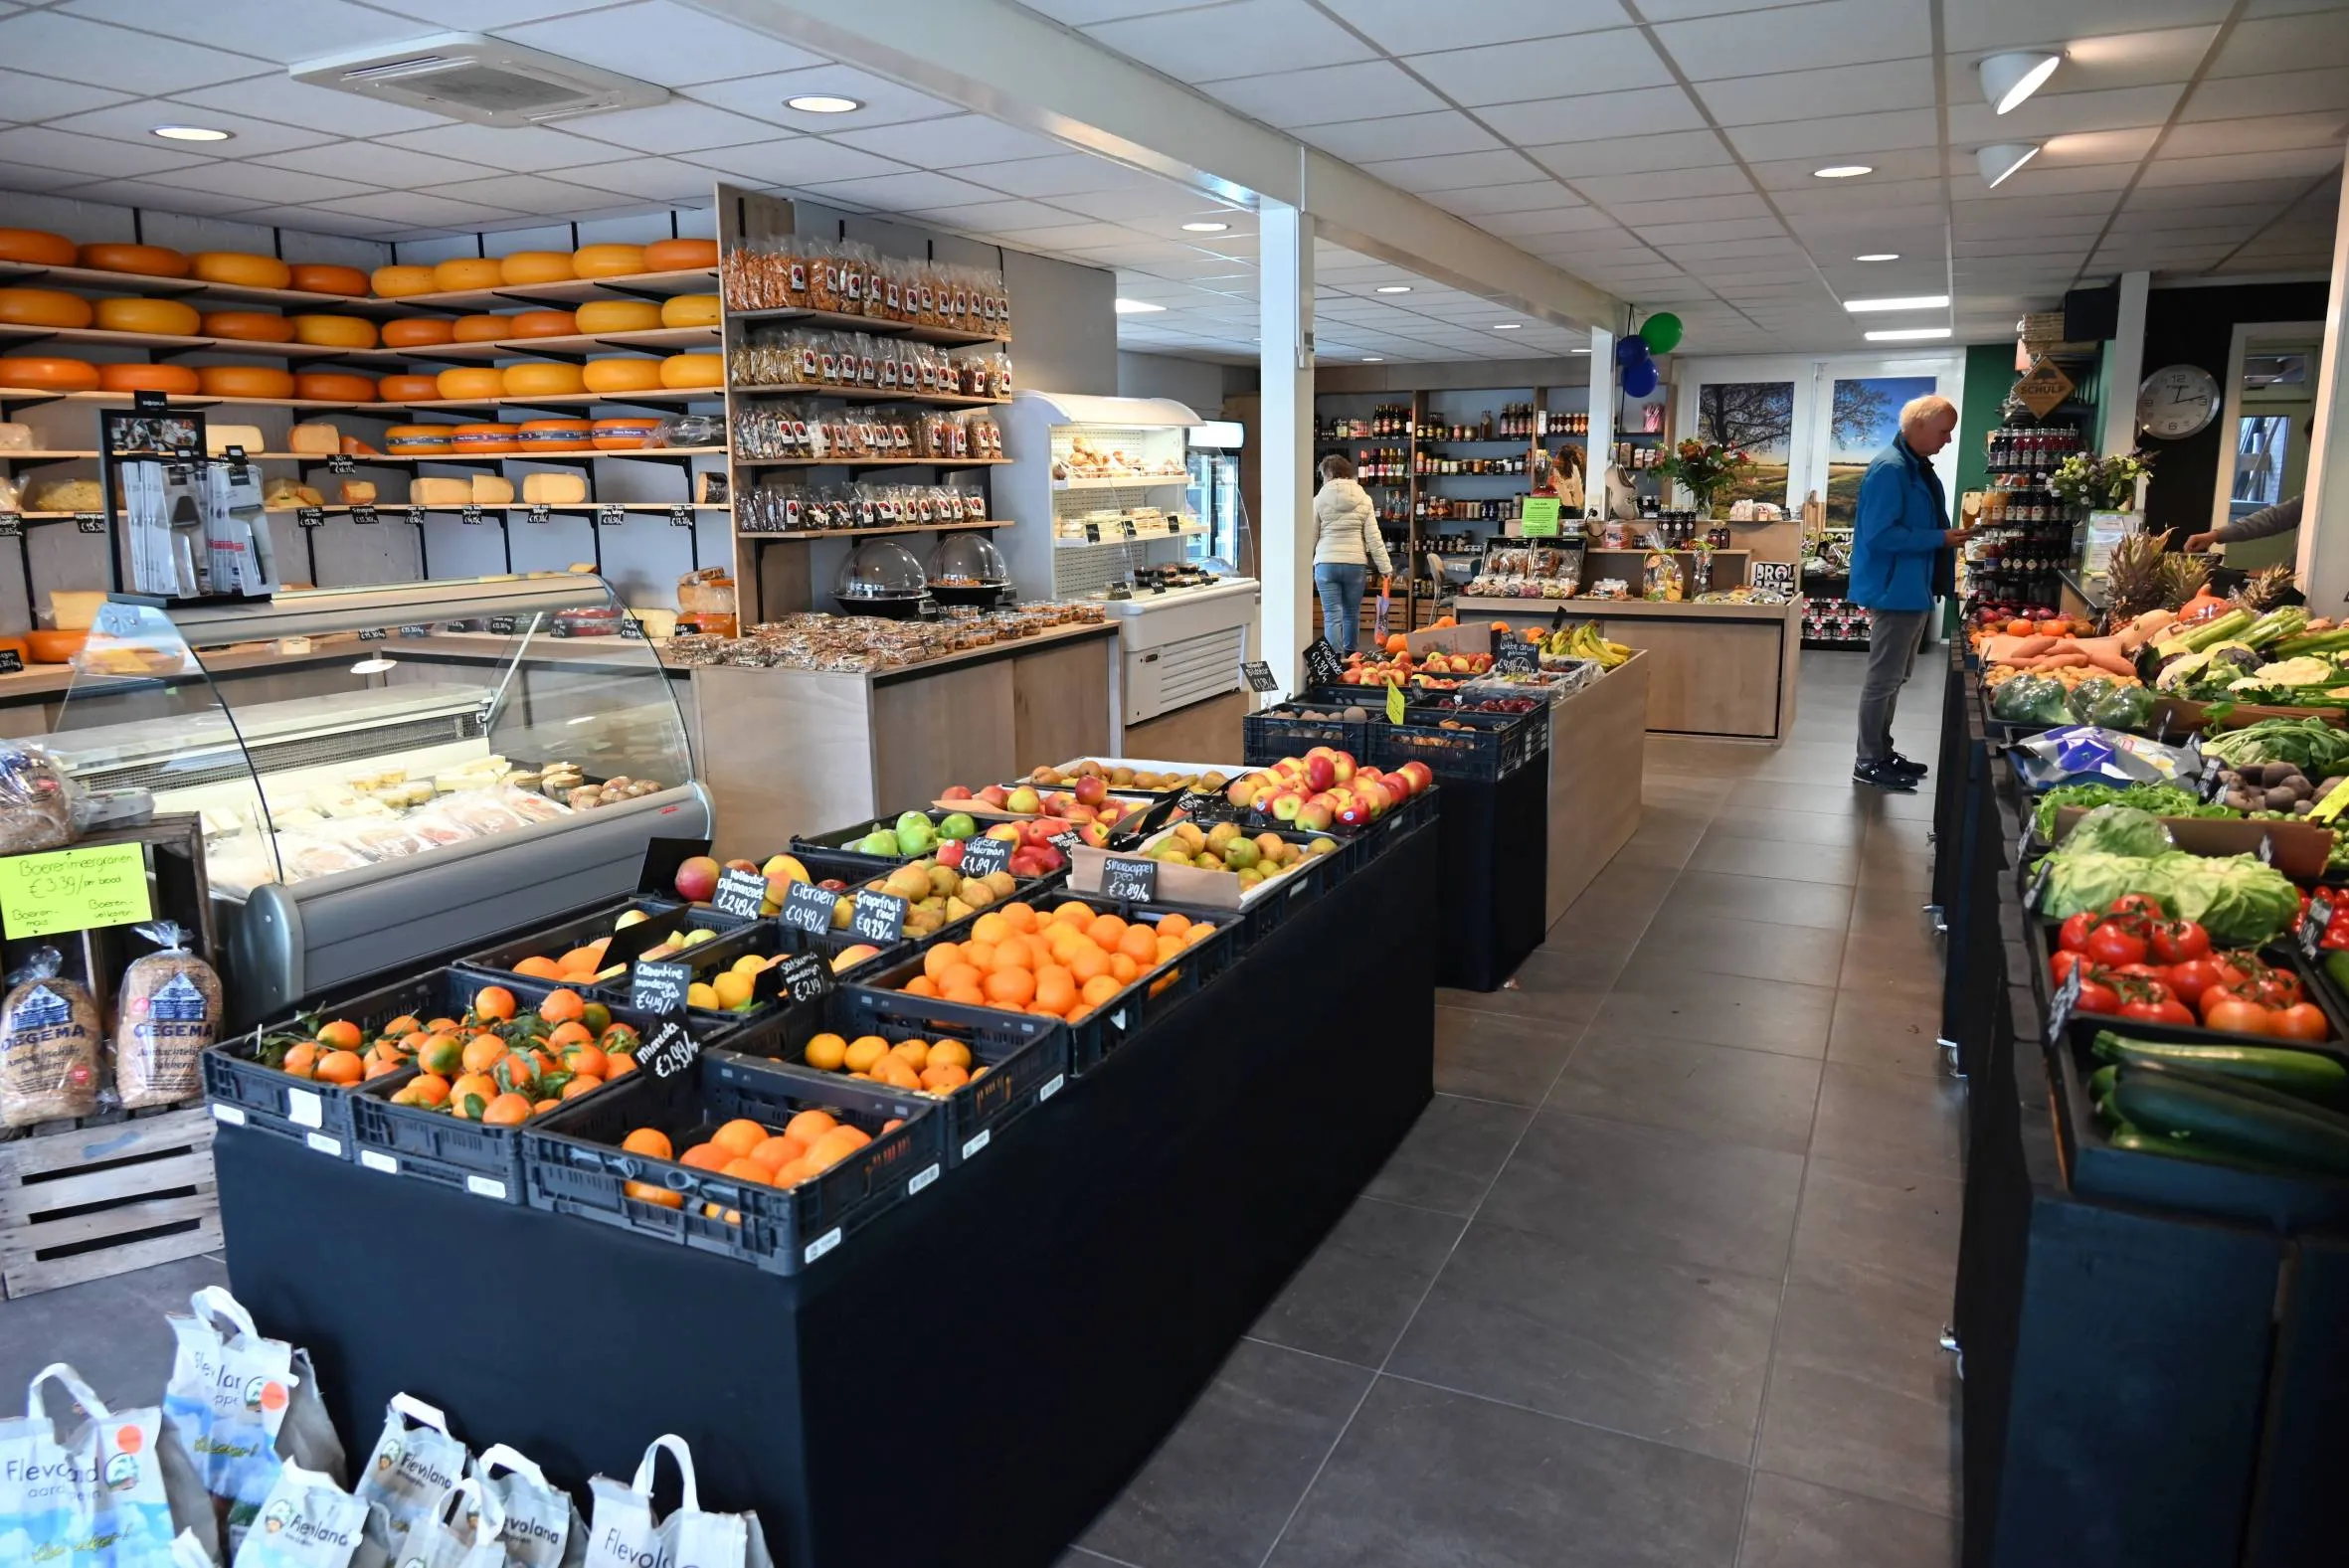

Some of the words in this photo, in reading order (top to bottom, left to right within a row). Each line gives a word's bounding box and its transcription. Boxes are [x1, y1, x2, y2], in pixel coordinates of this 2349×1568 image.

[2172, 374, 2187, 383] 12
[2199, 398, 2208, 407] 3
[2168, 422, 2178, 431] 6
[792, 882, 835, 907] Citroen
